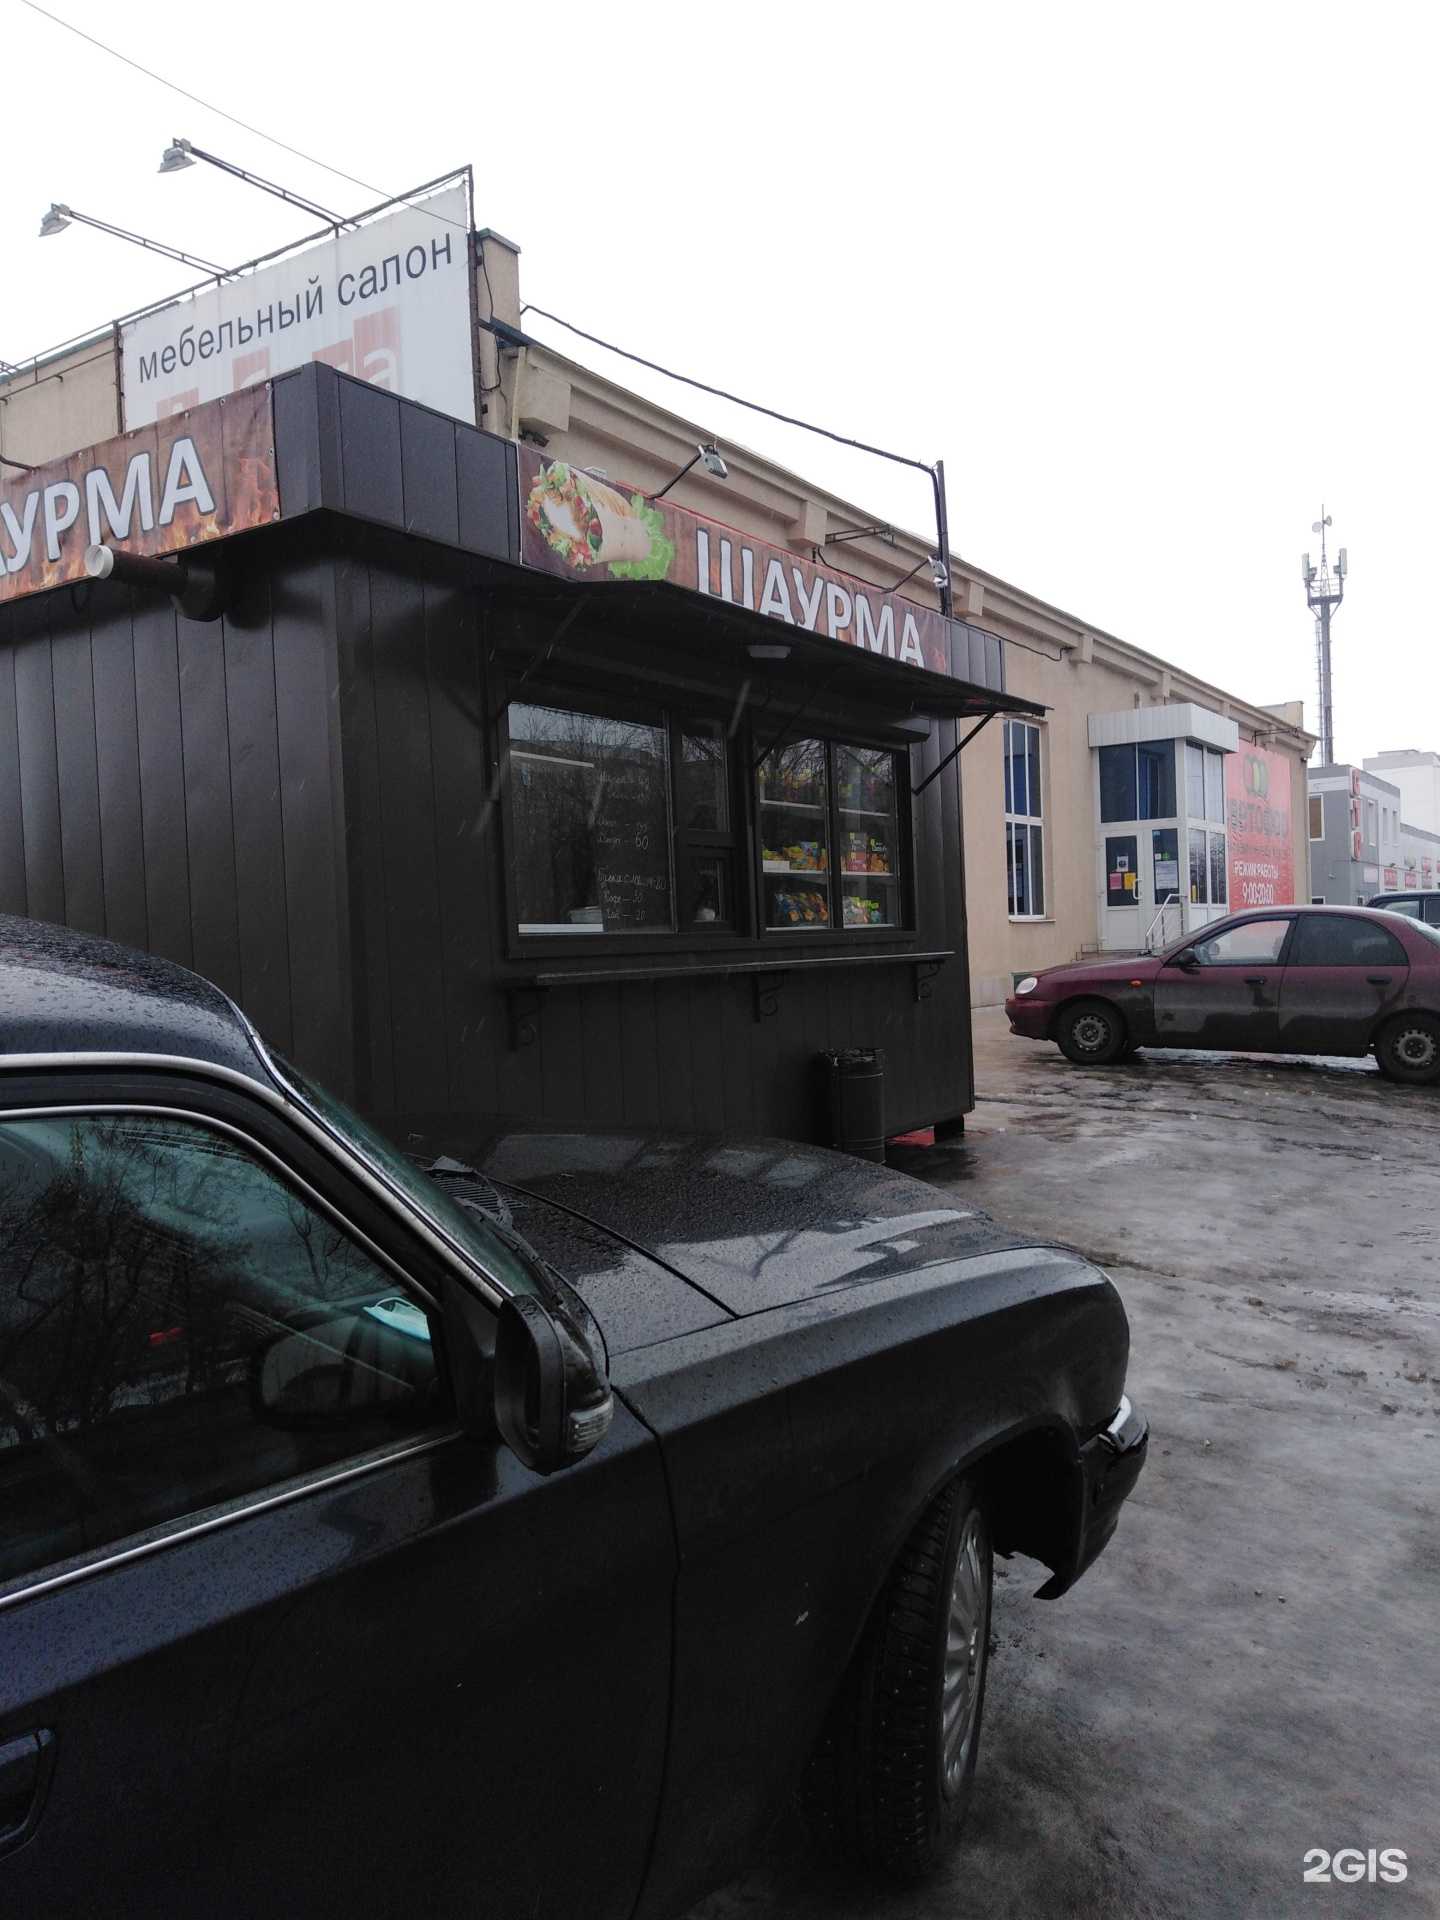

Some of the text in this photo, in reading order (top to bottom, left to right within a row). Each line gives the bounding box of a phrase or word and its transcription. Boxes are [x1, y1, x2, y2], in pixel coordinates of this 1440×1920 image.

[138, 279, 324, 383] мебельный
[337, 232, 453, 306] салон
[0, 437, 216, 577] УРМА
[696, 529, 925, 668] ШАУРМА
